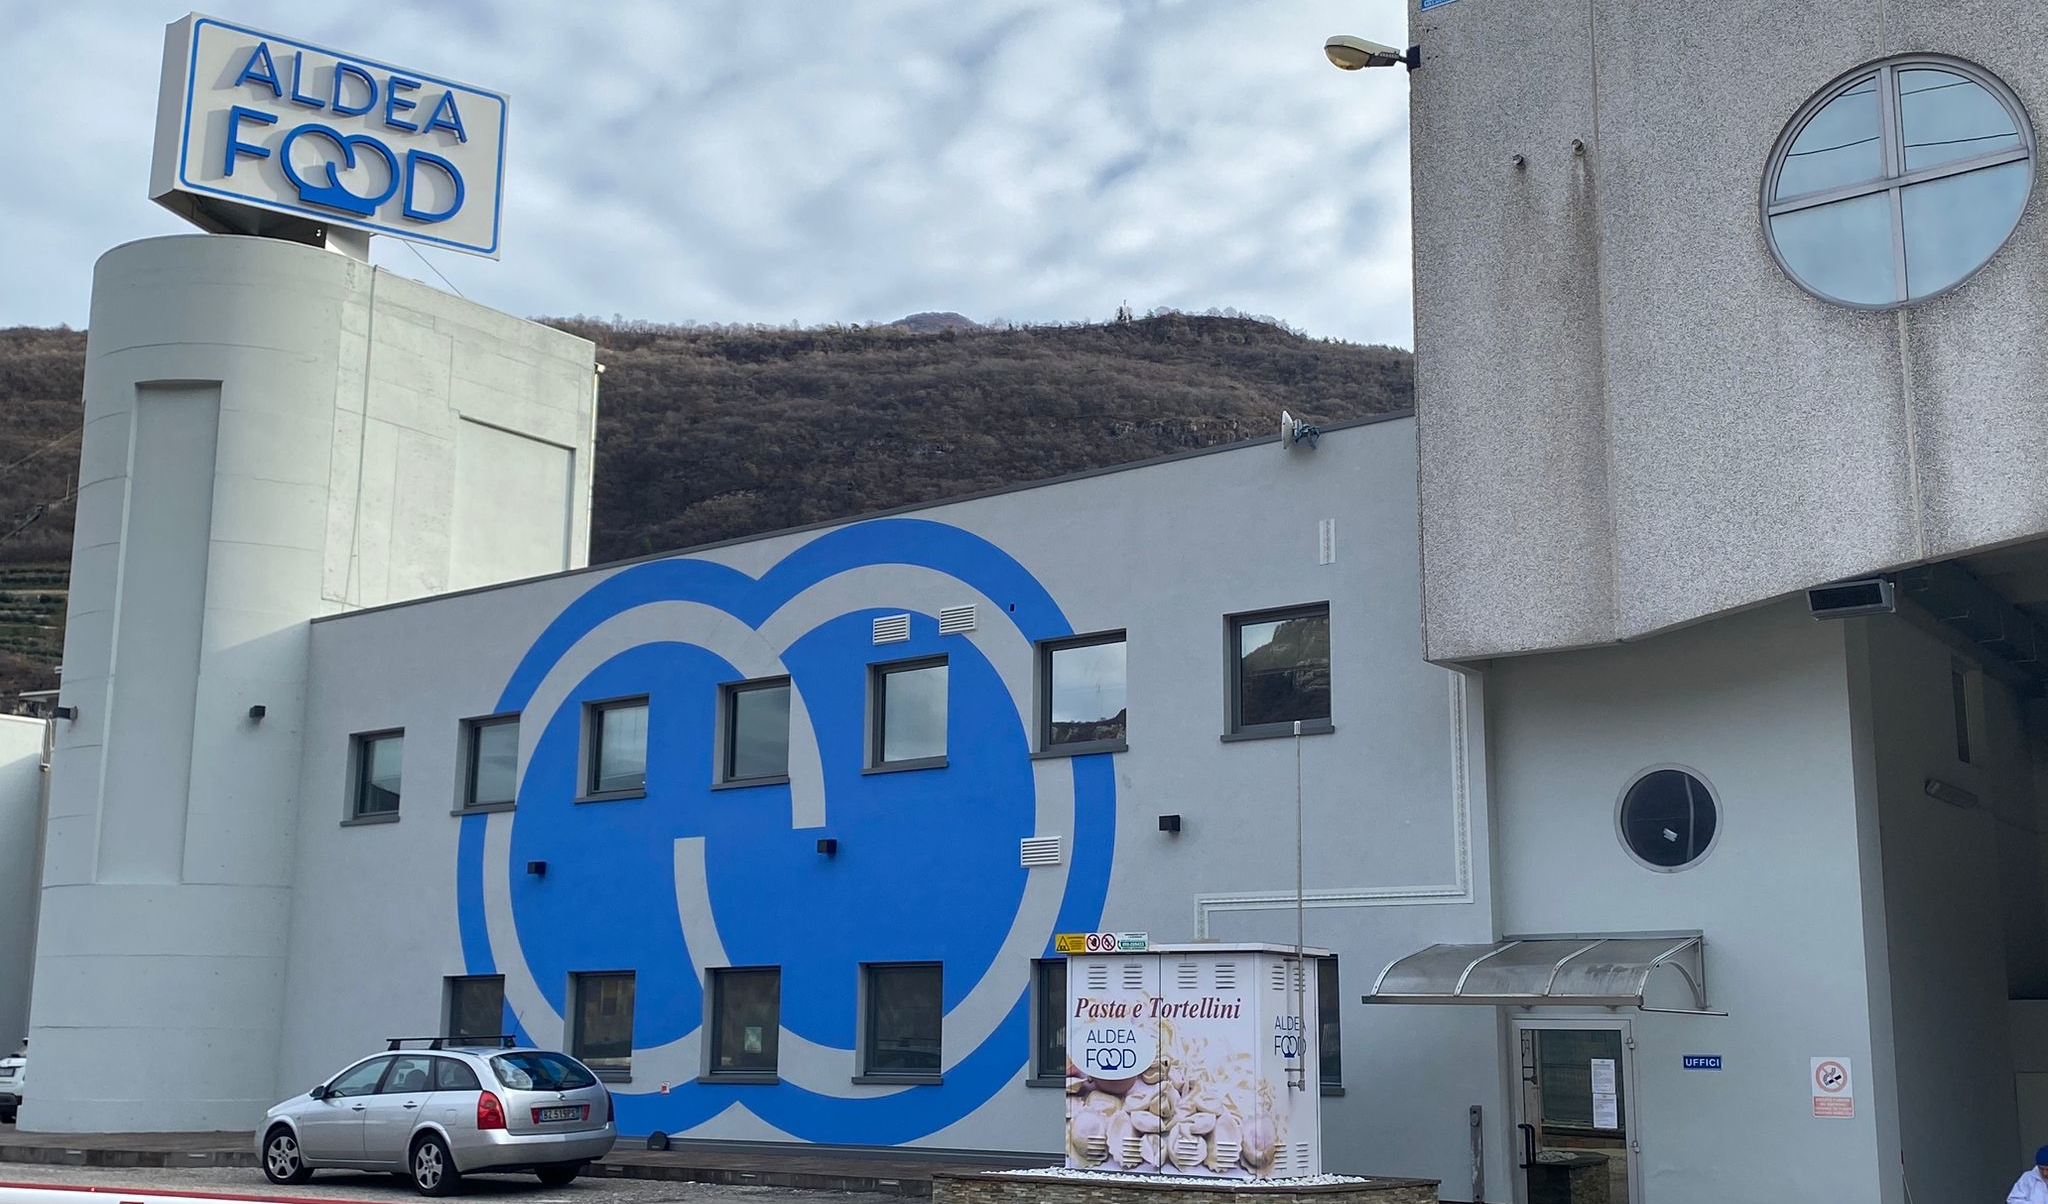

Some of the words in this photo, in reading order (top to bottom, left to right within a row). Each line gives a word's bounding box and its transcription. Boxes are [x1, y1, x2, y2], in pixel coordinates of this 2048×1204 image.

[235, 41, 468, 144] ALDEA
[224, 105, 465, 223] FOOD
[1074, 997, 1126, 1018] Pasta
[1132, 1003, 1143, 1018] e
[1149, 997, 1242, 1019] Tortellini
[1086, 1029, 1136, 1044] ALDEA
[1086, 1047, 1137, 1070] FOOD
[1685, 1058, 1720, 1067] UFFICI
